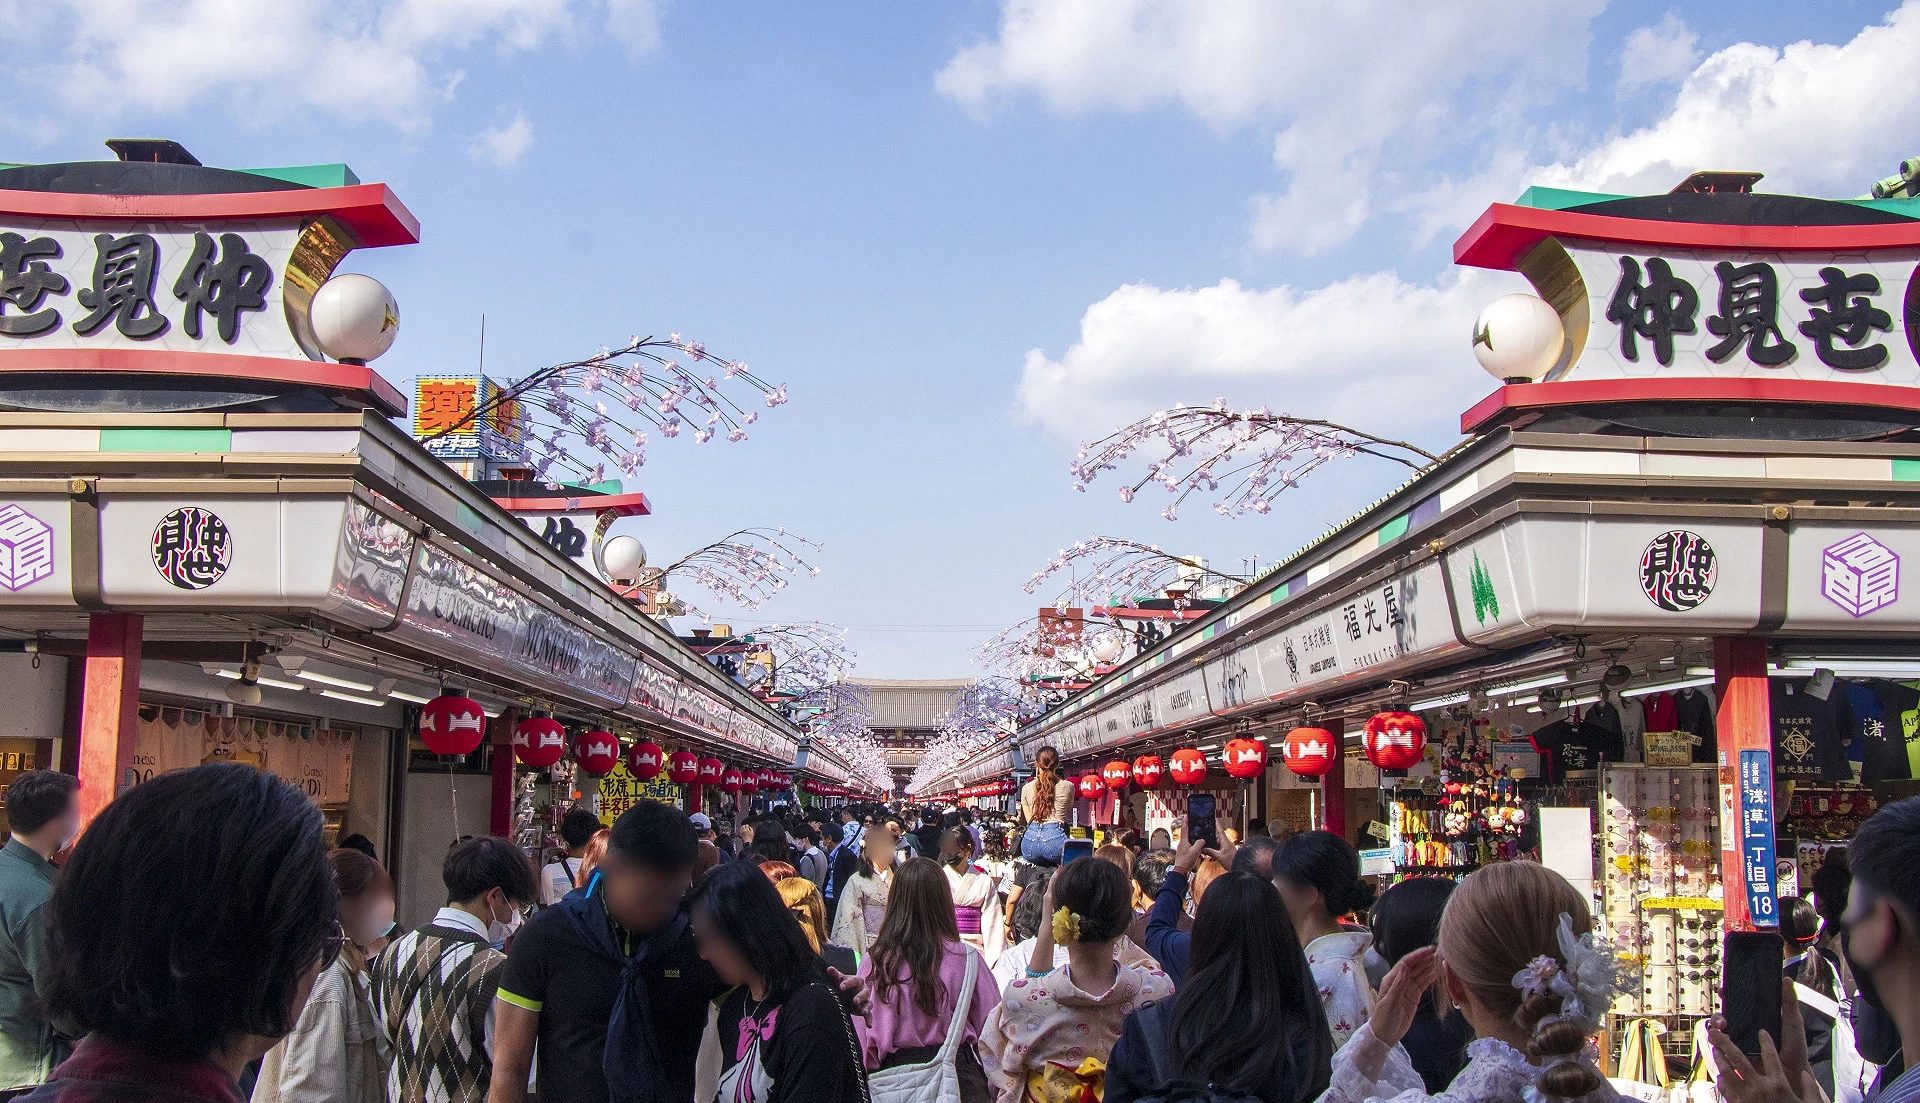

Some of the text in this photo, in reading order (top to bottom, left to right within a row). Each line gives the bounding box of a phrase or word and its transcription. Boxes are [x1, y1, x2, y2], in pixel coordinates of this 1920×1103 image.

[1606, 255, 1893, 370] 仲見世
[419, 382, 476, 430] 薬
[1344, 585, 1404, 643] 福光屋
[1789, 738, 1805, 753] 福
[1751, 762, 1760, 784] 台東区
[1749, 788, 1767, 882] 浅草一丁目
[1746, 856, 1754, 882] 1-CHOME
[1752, 896, 1773, 915] 18
